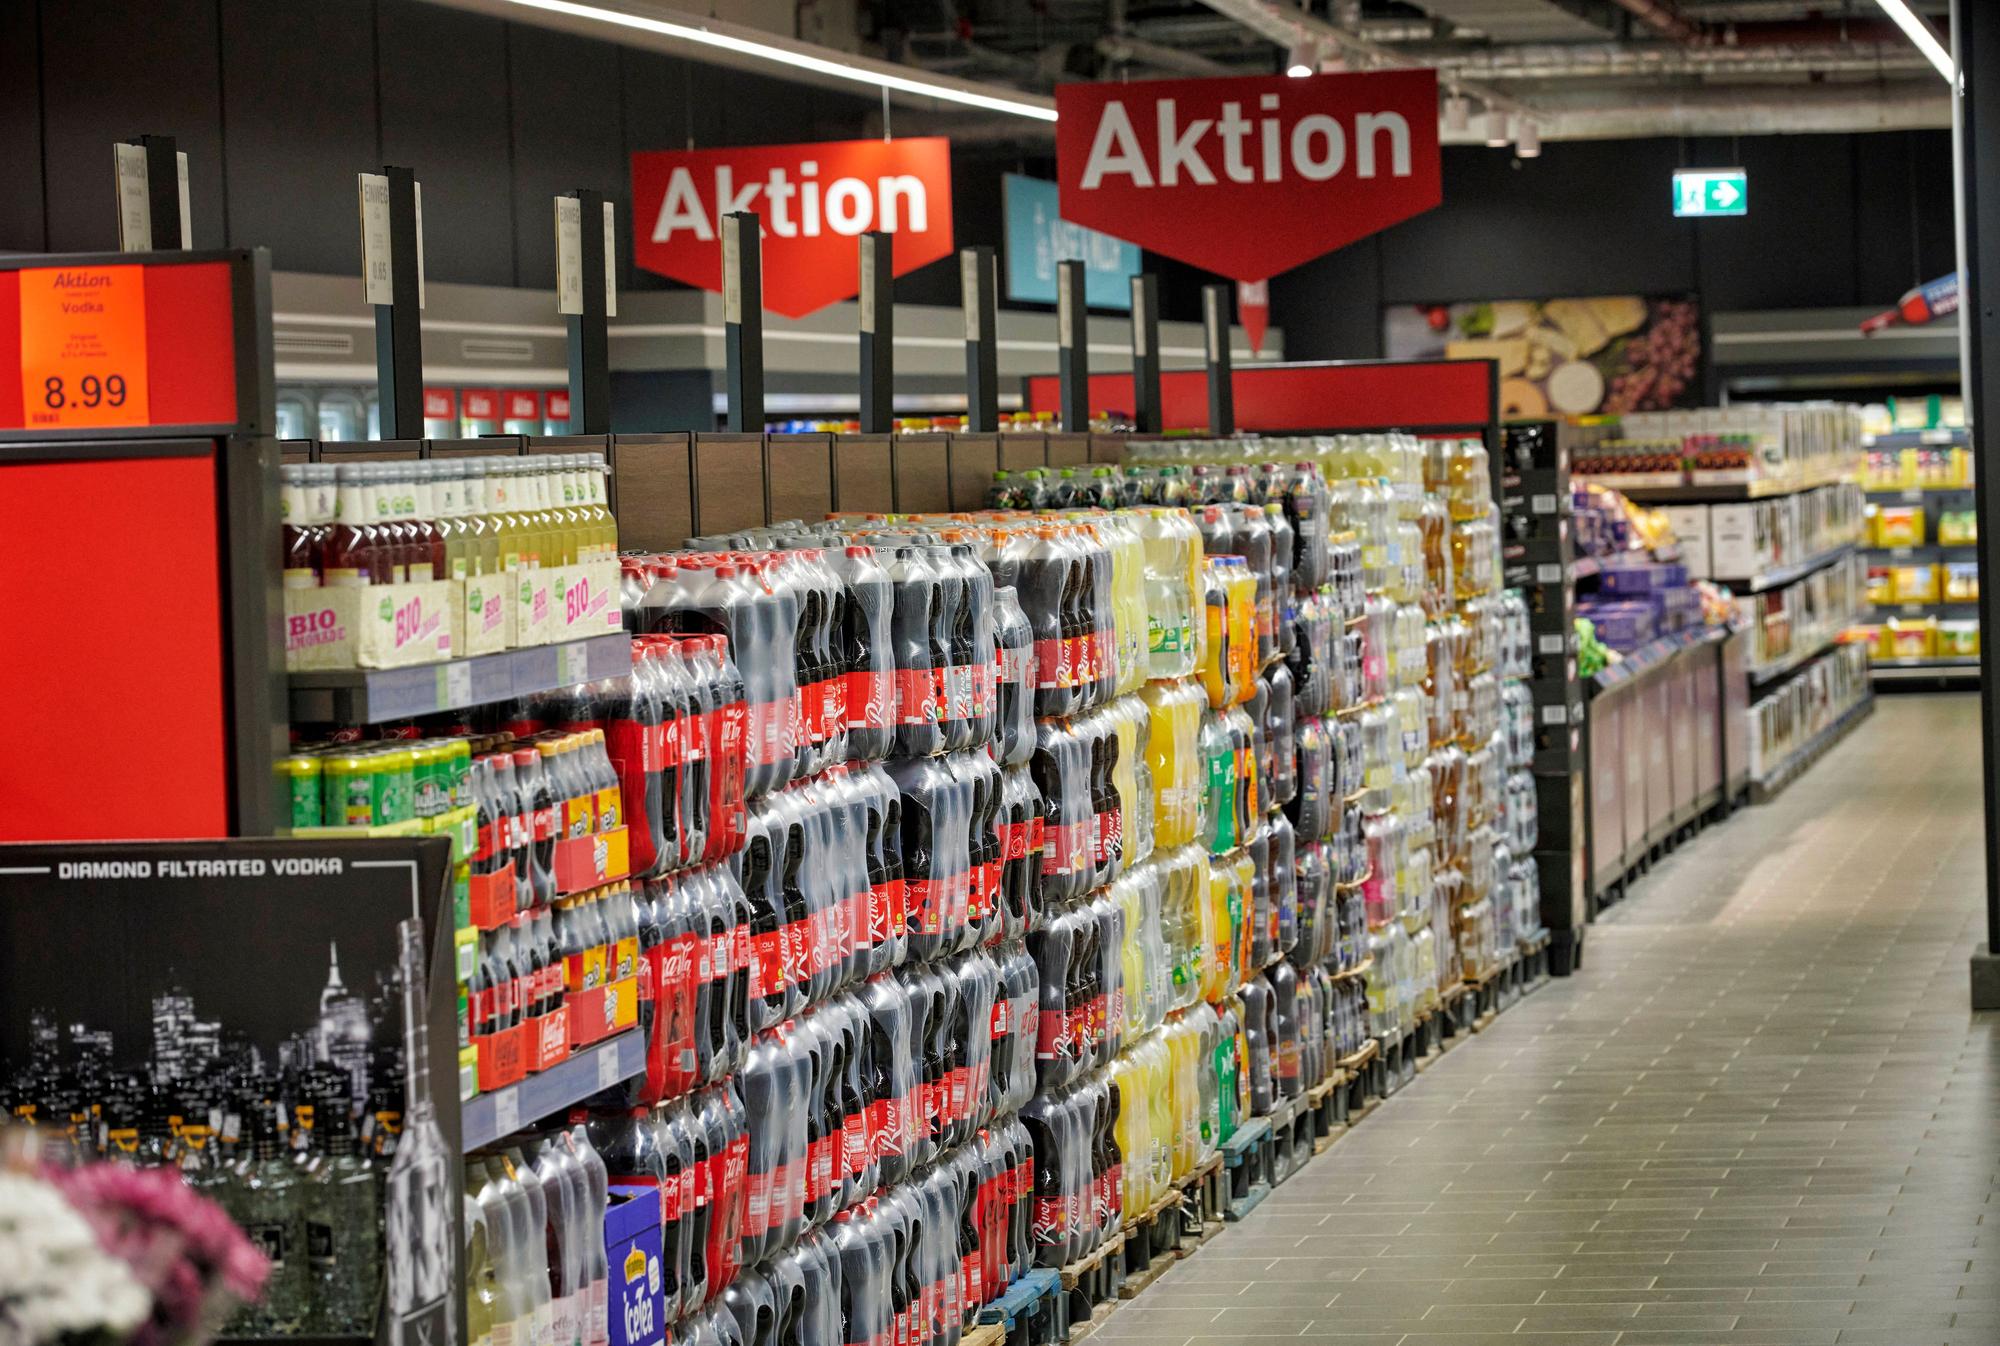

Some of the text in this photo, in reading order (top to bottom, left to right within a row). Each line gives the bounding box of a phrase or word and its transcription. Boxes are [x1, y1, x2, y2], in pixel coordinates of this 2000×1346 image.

[1080, 94, 1412, 190] Aktion
[651, 160, 928, 242] Aktion
[54, 272, 112, 289] Aktion
[61, 303, 105, 314] Vodka
[44, 374, 127, 409] 8.99
[288, 608, 337, 637] BIO
[395, 596, 421, 649] BIO
[566, 576, 589, 626] BIO
[1056, 642, 1072, 689] River
[865, 673, 885, 727] River
[58, 858, 344, 880] DIAMOND FILTRATED VODKA
[1053, 1013, 1073, 1058] River
[877, 1101, 903, 1154] River
[1032, 1198, 1057, 1245] River
